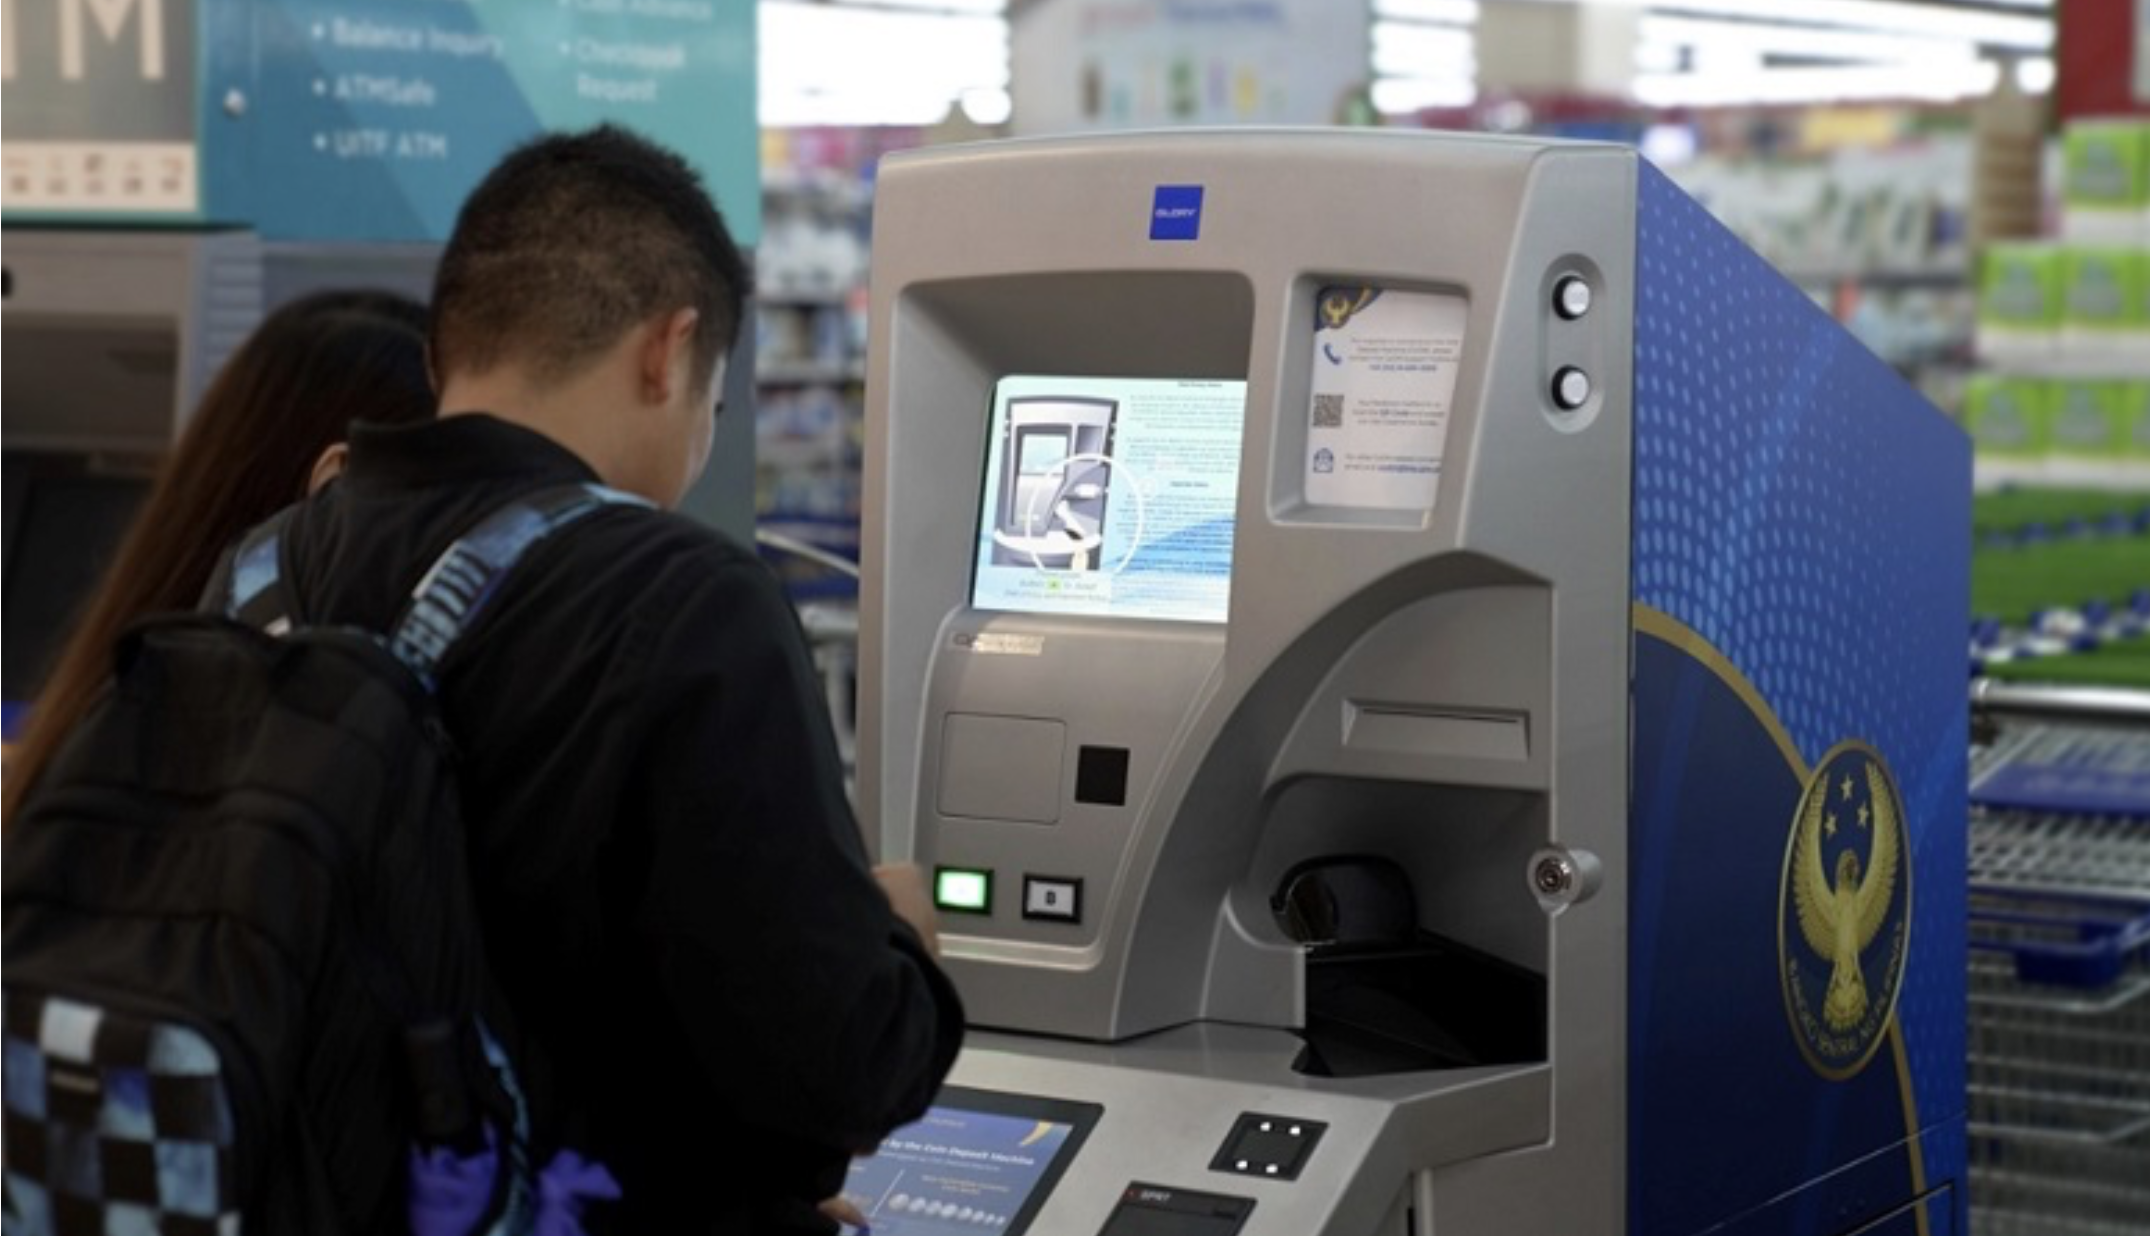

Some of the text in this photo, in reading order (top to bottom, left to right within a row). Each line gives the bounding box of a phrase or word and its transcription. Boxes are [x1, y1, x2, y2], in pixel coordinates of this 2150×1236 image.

[333, 16, 421, 48] Balance
[335, 74, 436, 106] ATMSafe
[397, 133, 447, 158] ATM
